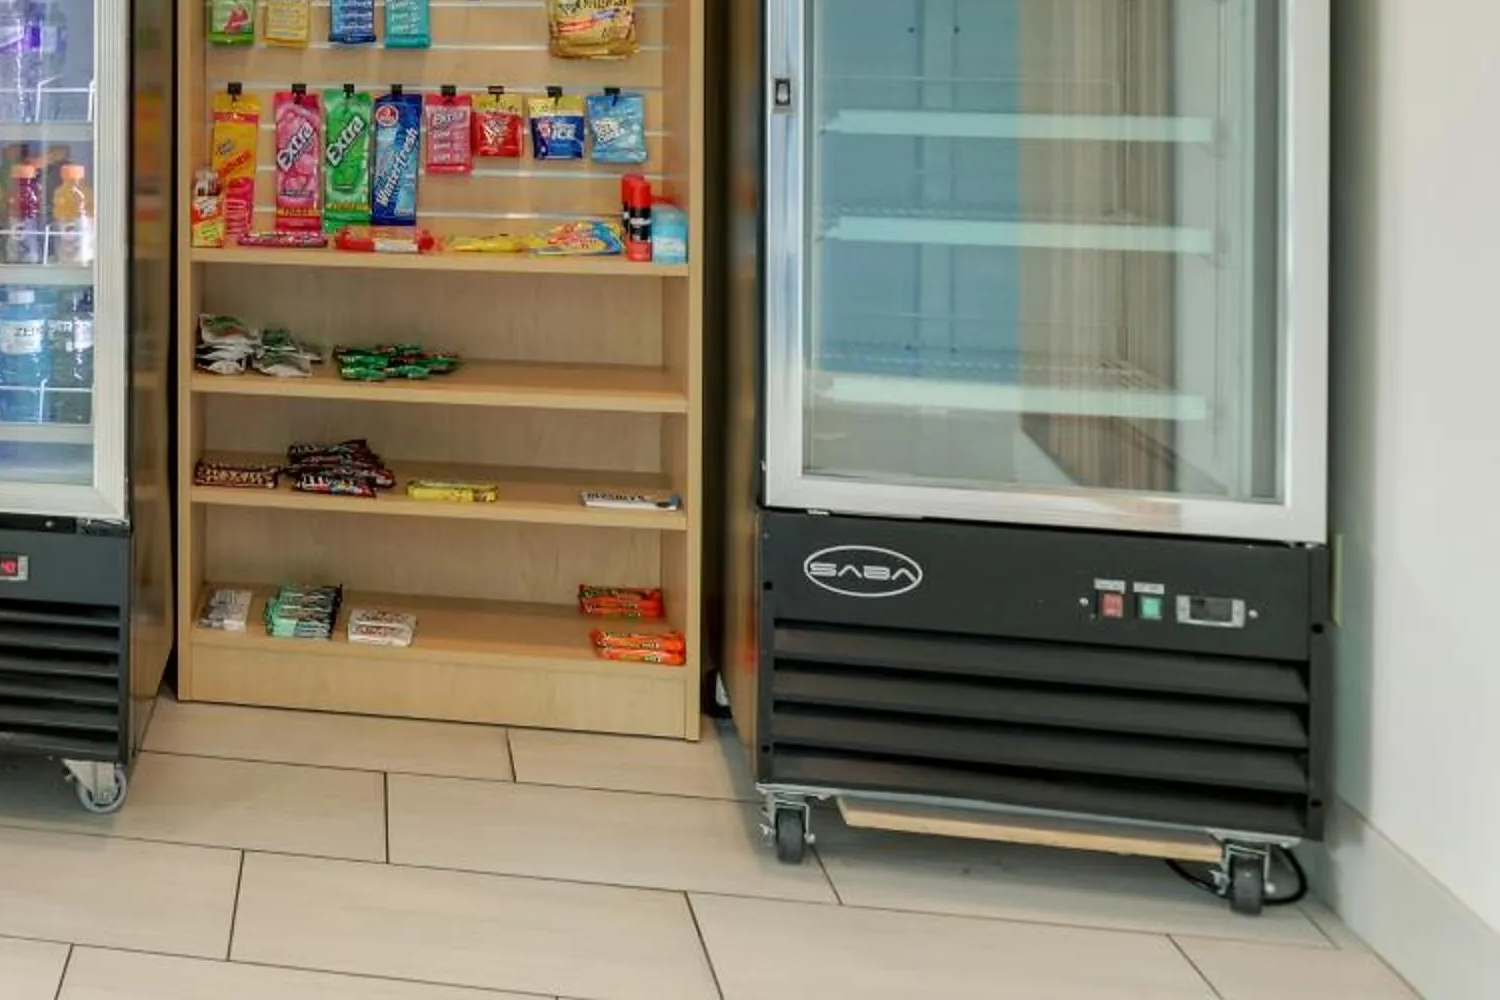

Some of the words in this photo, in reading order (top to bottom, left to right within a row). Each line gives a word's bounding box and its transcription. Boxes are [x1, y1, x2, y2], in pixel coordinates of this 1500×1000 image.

[276, 119, 315, 171] Extra
[325, 115, 366, 167] Extra
[375, 126, 419, 208] Winterfresh
[809, 562, 917, 582] SABA
